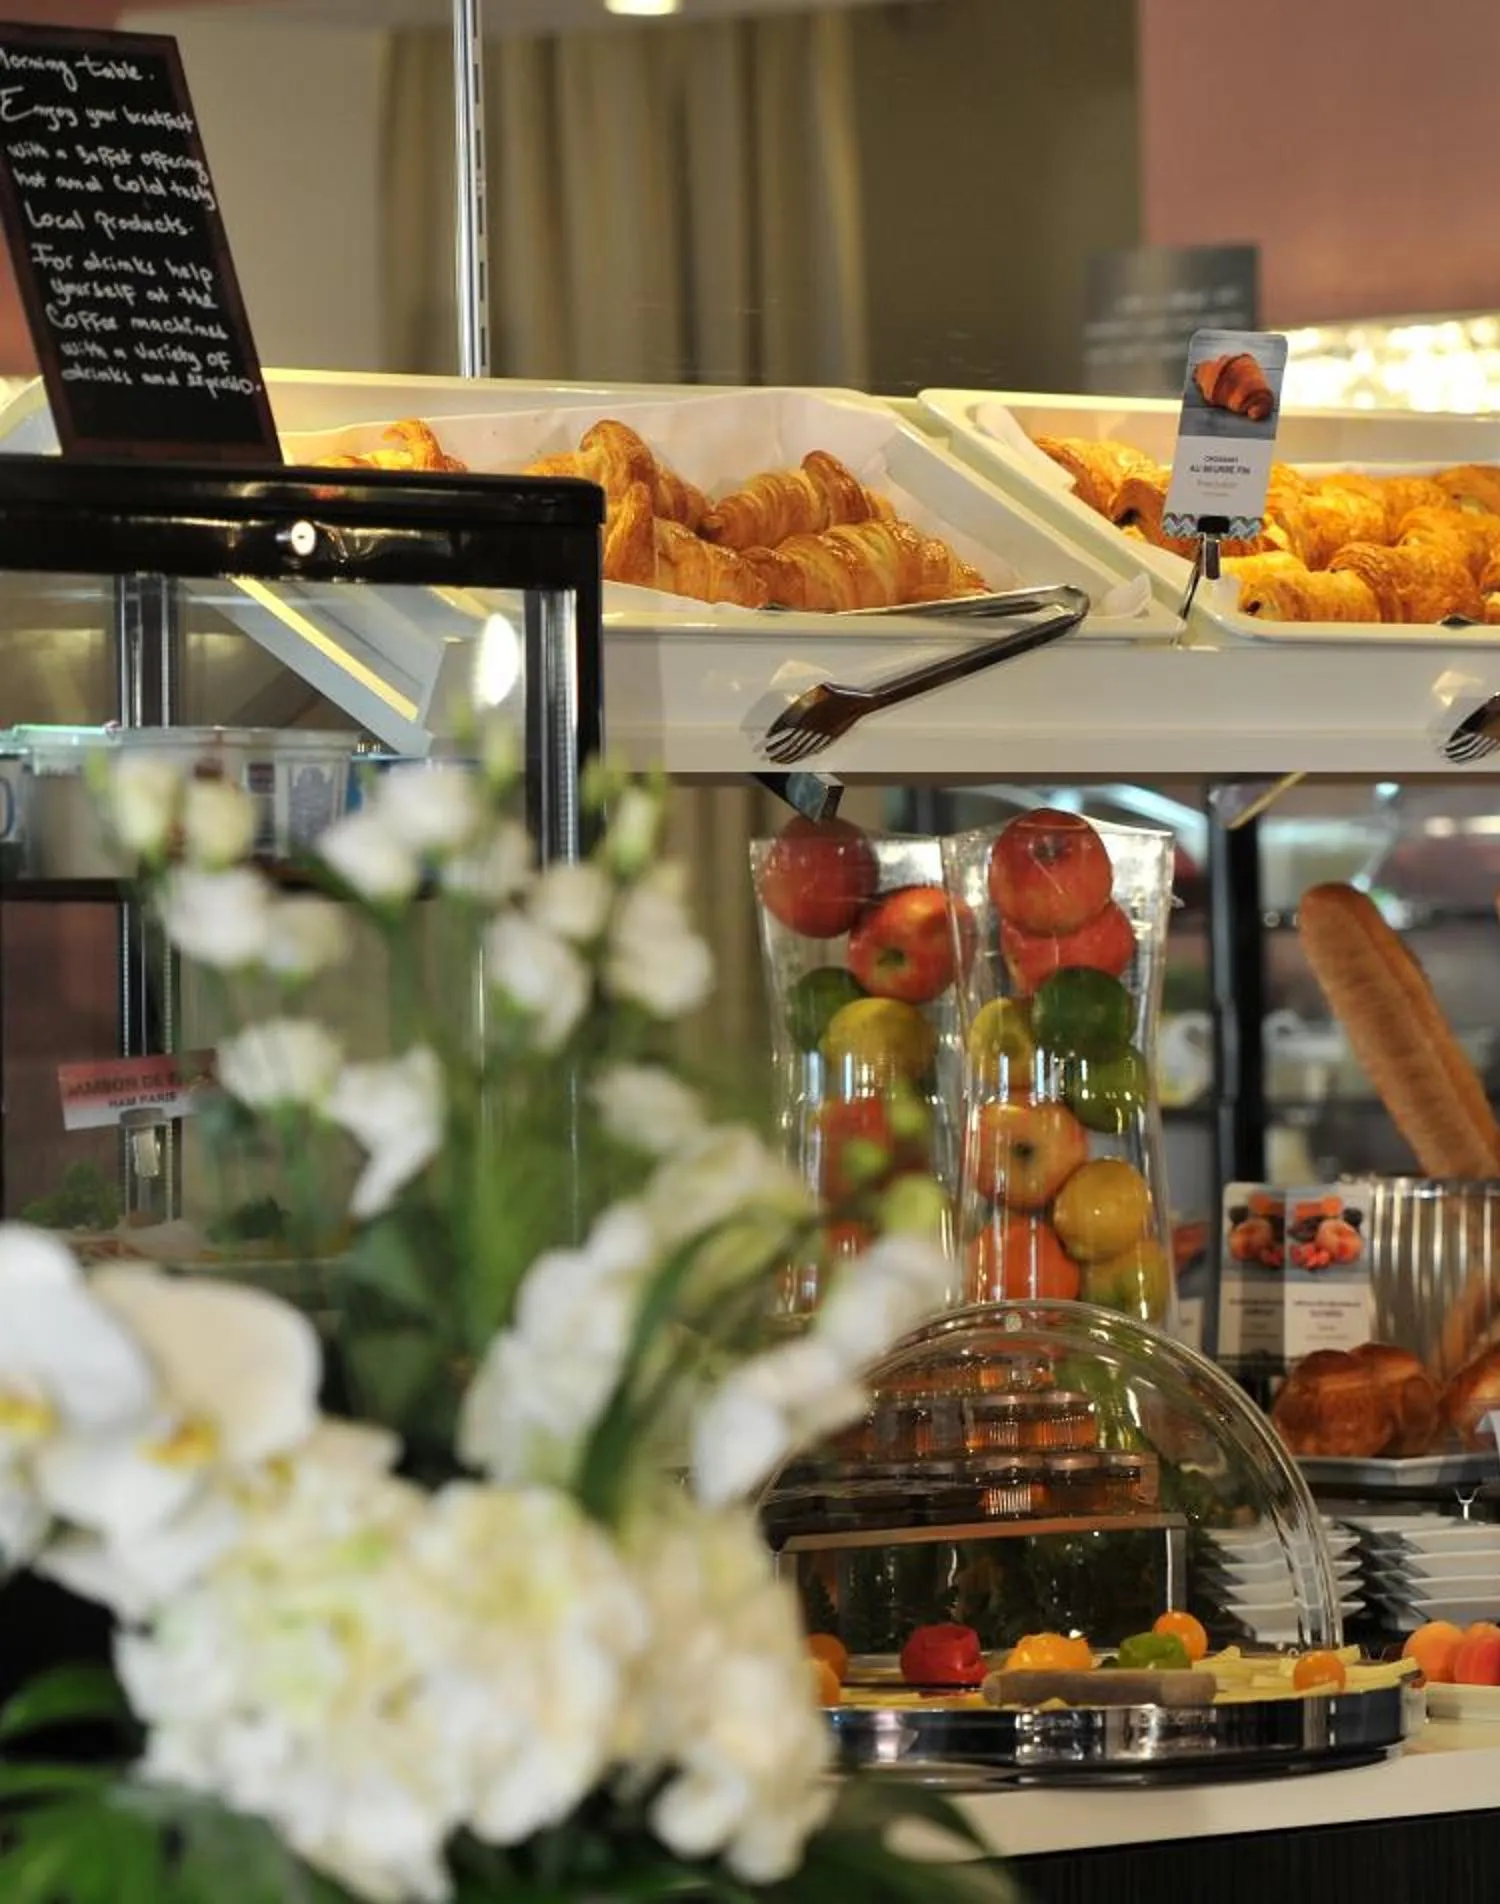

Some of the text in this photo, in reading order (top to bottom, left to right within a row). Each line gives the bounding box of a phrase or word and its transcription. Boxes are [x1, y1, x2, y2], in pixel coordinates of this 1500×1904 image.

[0, 85, 79, 132] Enjoy
[122, 105, 193, 133] breakfast
[56, 174, 103, 192] and
[31, 242, 213, 292] For drinks help
[146, 286, 169, 304] at
[177, 287, 219, 309] the
[113, 347, 128, 360] a
[206, 350, 231, 372] of
[61, 361, 133, 386] drinks
[141, 370, 180, 387] and
